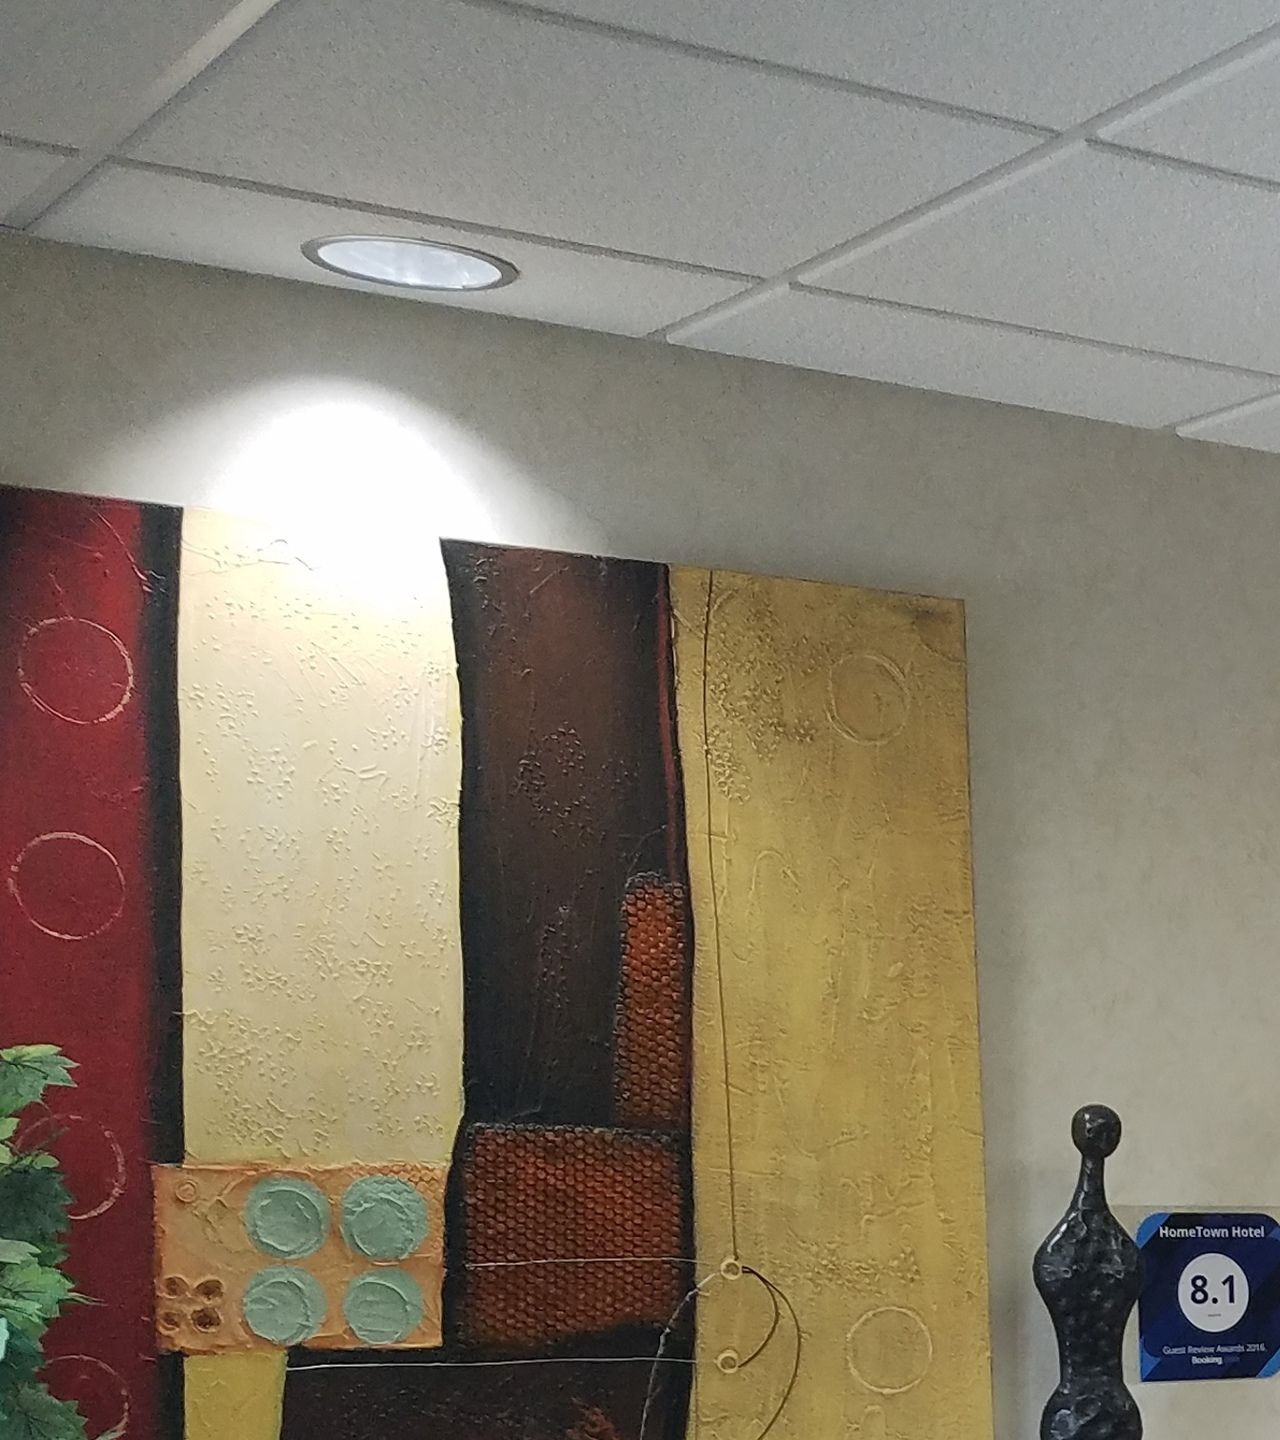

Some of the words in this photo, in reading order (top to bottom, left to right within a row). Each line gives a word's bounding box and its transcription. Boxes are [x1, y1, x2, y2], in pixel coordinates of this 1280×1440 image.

[1159, 1226, 1229, 1238] HomeTown
[1231, 1225, 1265, 1238] Hotel
[1190, 1274, 1235, 1305] 8.1
